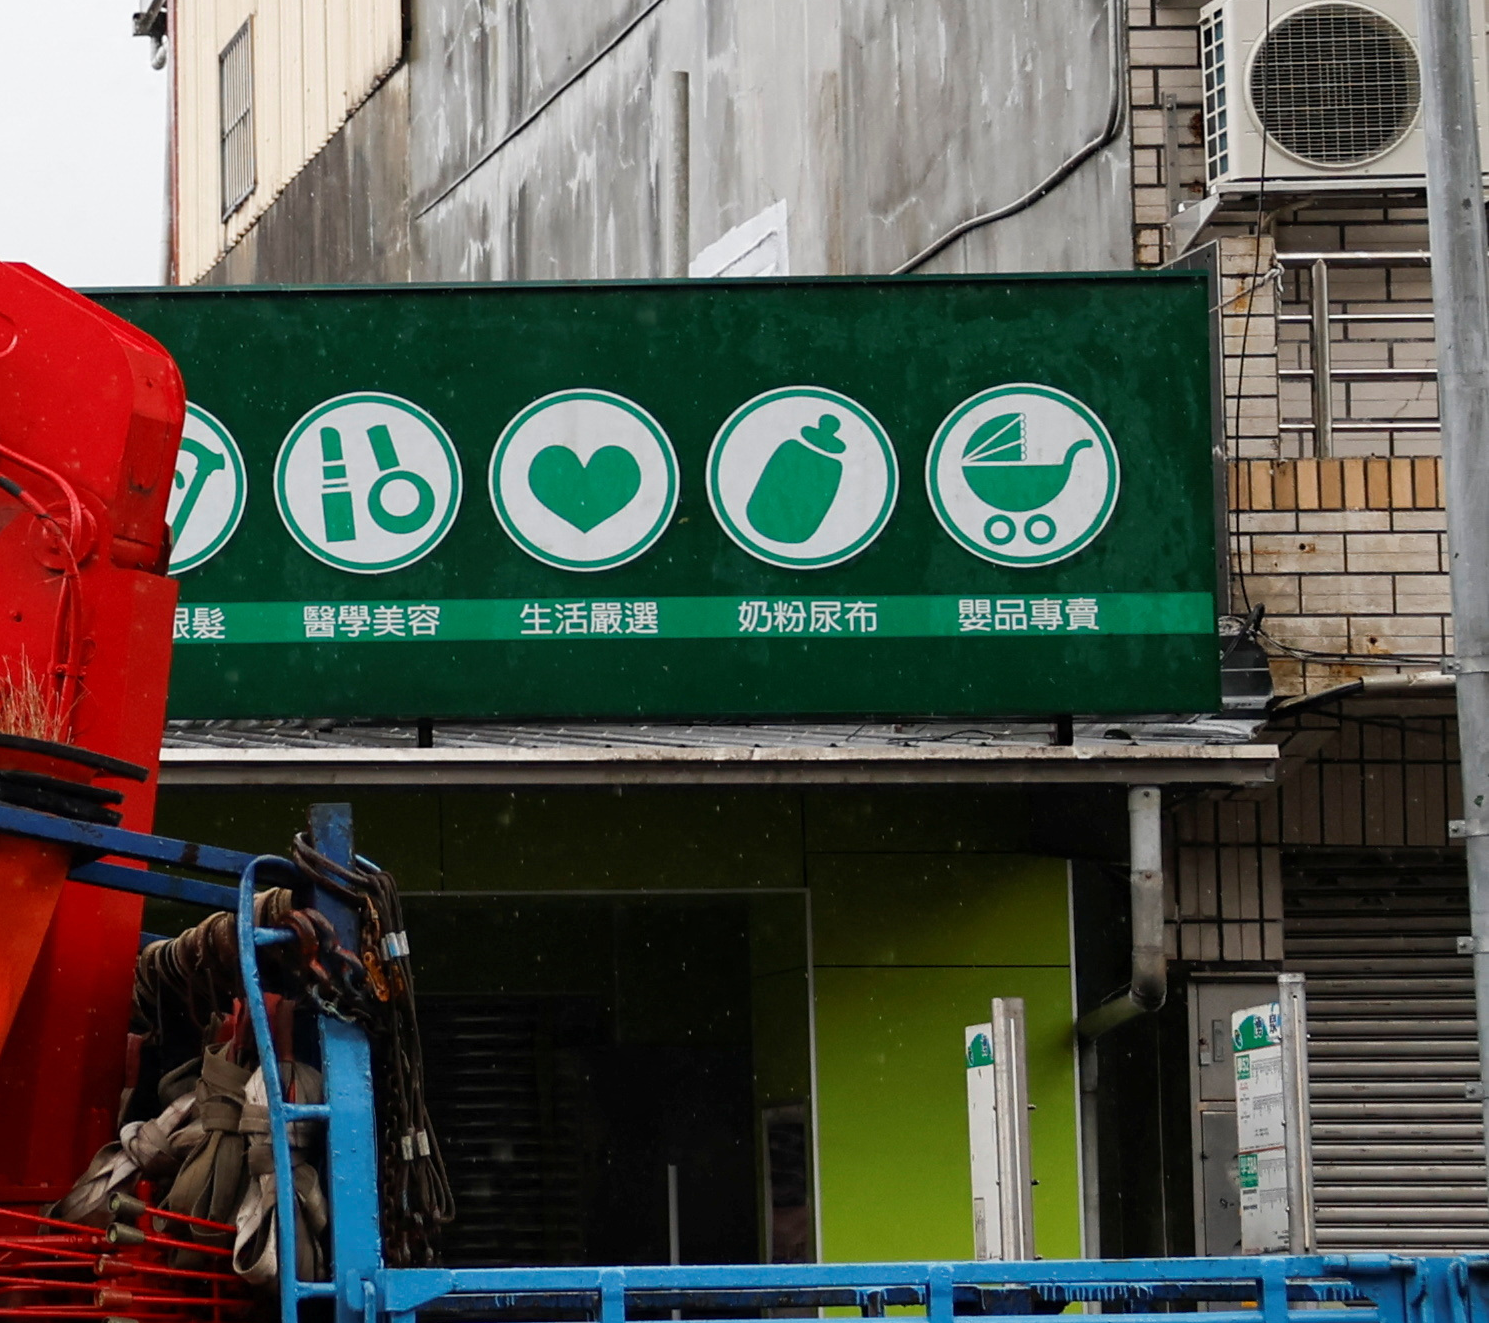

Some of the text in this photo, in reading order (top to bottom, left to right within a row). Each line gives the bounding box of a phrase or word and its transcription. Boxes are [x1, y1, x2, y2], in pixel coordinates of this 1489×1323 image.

[302, 604, 441, 638] 醫學美容
[519, 601, 659, 636] 生活嚴選
[737, 600, 878, 633] 奶粉尿布
[957, 597, 1100, 632] 嬰品專賣
